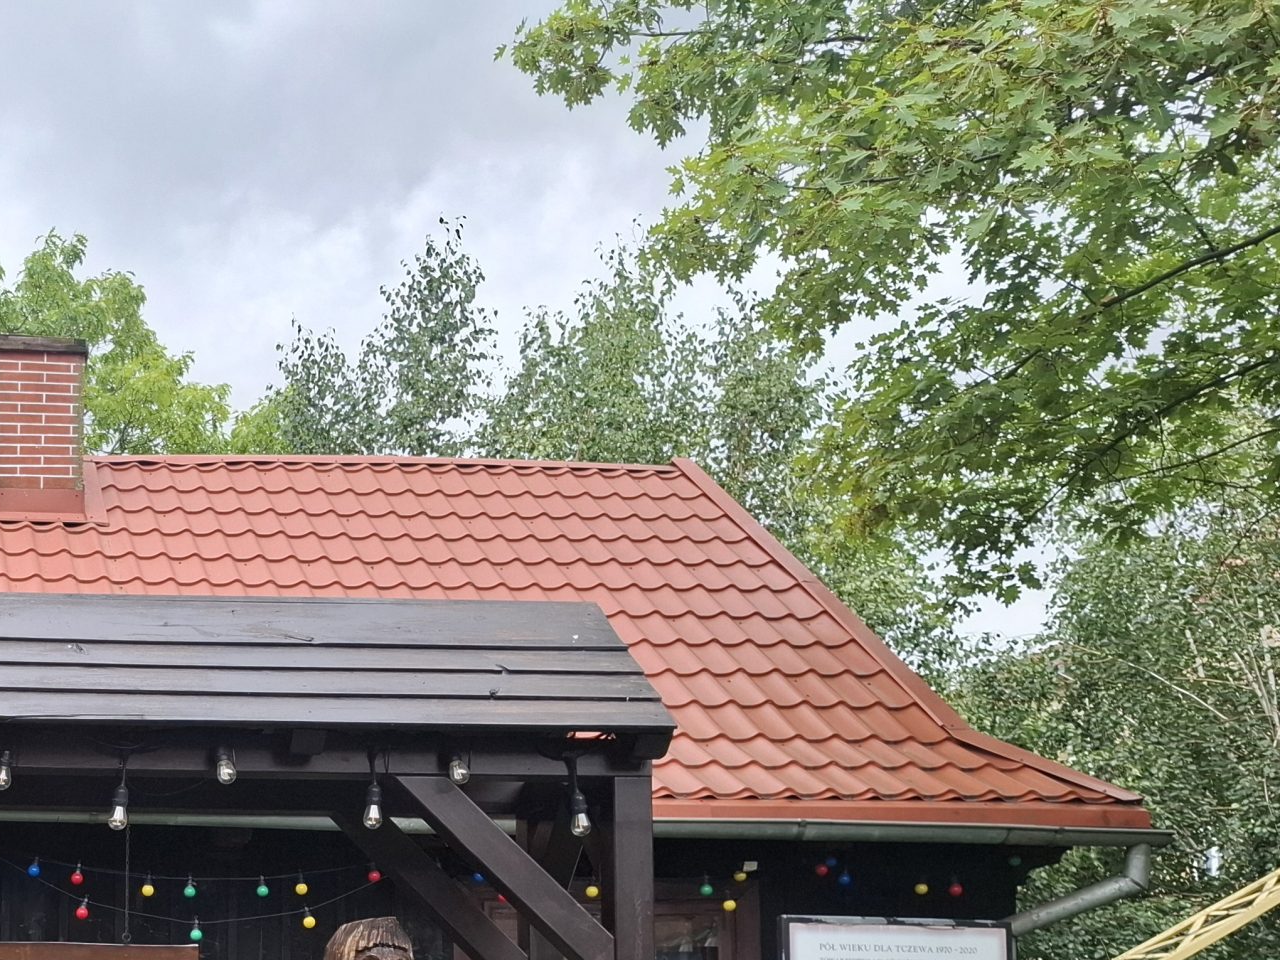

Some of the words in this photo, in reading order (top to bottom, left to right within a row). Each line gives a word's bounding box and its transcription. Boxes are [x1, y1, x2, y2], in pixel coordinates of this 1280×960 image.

[839, 943, 871, 952] WIEKU
[873, 944, 892, 953] DLA
[894, 945, 933, 954] TCZEWA
[935, 946, 952, 954] 1970
[959, 946, 978, 954] 2020
